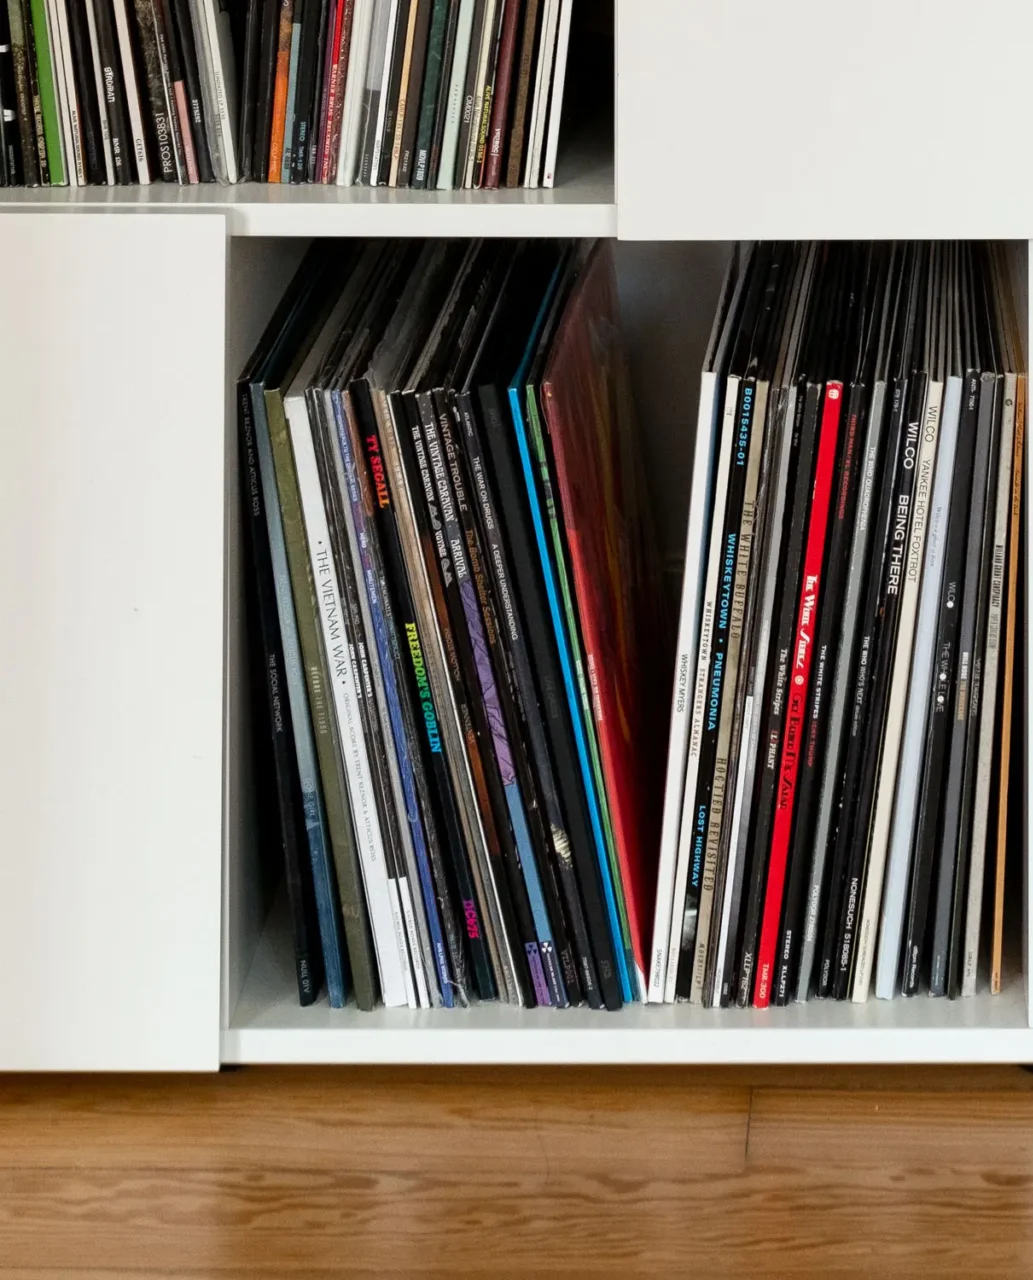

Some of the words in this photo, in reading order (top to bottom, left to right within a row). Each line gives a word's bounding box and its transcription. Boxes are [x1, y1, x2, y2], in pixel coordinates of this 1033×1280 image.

[366, 435, 379, 452] TY
[424, 423, 437, 439] THE
[736, 388, 752, 466] B0015435-01
[924, 406, 938, 442] WILCO
[428, 442, 445, 479] VINTAGE
[438, 413, 456, 460] VINTAGE
[448, 462, 467, 511] TROUBLE
[472, 457, 482, 471] THE
[903, 422, 918, 469] WILCO
[370, 456, 390, 508] SEGALL
[476, 473, 486, 489] WAR
[479, 491, 489, 502] ON
[918, 460, 930, 497] YANKEE
[437, 481, 455, 521] CARAVAN
[482, 504, 495, 529] DRUGS
[742, 501, 754, 525] THE
[894, 495, 909, 540] BEING
[913, 501, 925, 533] HOTEL
[315, 549, 330, 575] THE
[450, 539, 468, 578] ARRIVAL
[493, 551, 505, 578] DEEPER
[737, 534, 750, 576] WHITE
[887, 545, 903, 594] THERE
[907, 536, 921, 582] FOXTROT
[718, 534, 736, 629] WHISKEYTOWN
[320, 579, 340, 640] VIETNAM
[499, 580, 518, 640] UNDERSTANDING
[730, 584, 745, 639] BUFFALO
[332, 645, 347, 677] WAR
[678, 654, 688, 687] WHISKEY
[404, 623, 430, 698] FREEDOM'S
[421, 703, 442, 752] GOBLIN
[677, 688, 686, 712] MYERS
[708, 653, 723, 731] PNEUMONIA
[711, 758, 728, 814] HOGTIED
[695, 806, 705, 832] LOST
[691, 836, 703, 887] HIGHWAY
[703, 822, 721, 891] REVISITED
[463, 900, 478, 939] DC675
[845, 878, 858, 930] NONESUCH
[840, 934, 851, 971] 518085-1
[760, 964, 769, 998] TMR-300
